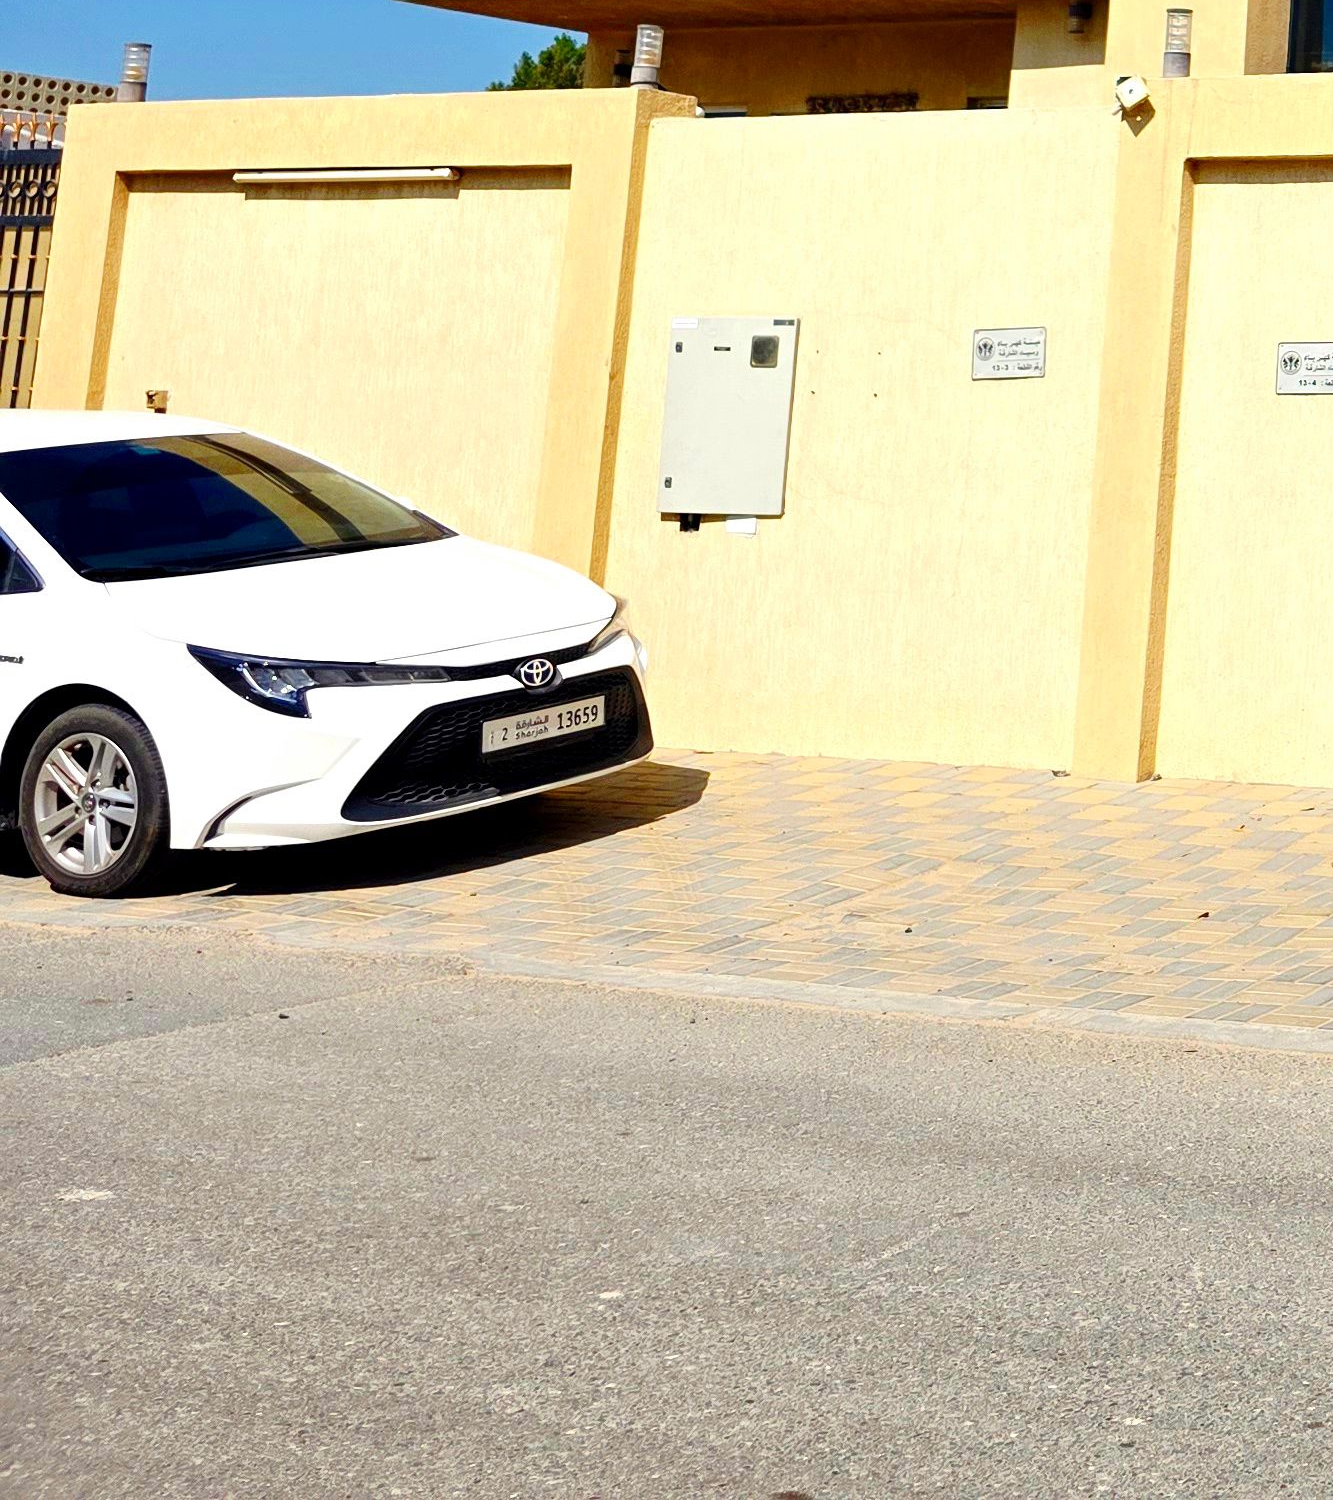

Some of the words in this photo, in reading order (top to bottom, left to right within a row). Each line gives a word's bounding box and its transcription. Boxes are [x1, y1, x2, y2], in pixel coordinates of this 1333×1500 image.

[515, 714, 549, 730] الشارقة
[557, 704, 598, 730] 13659
[501, 727, 508, 742] 2
[515, 725, 549, 740] Sharjah
